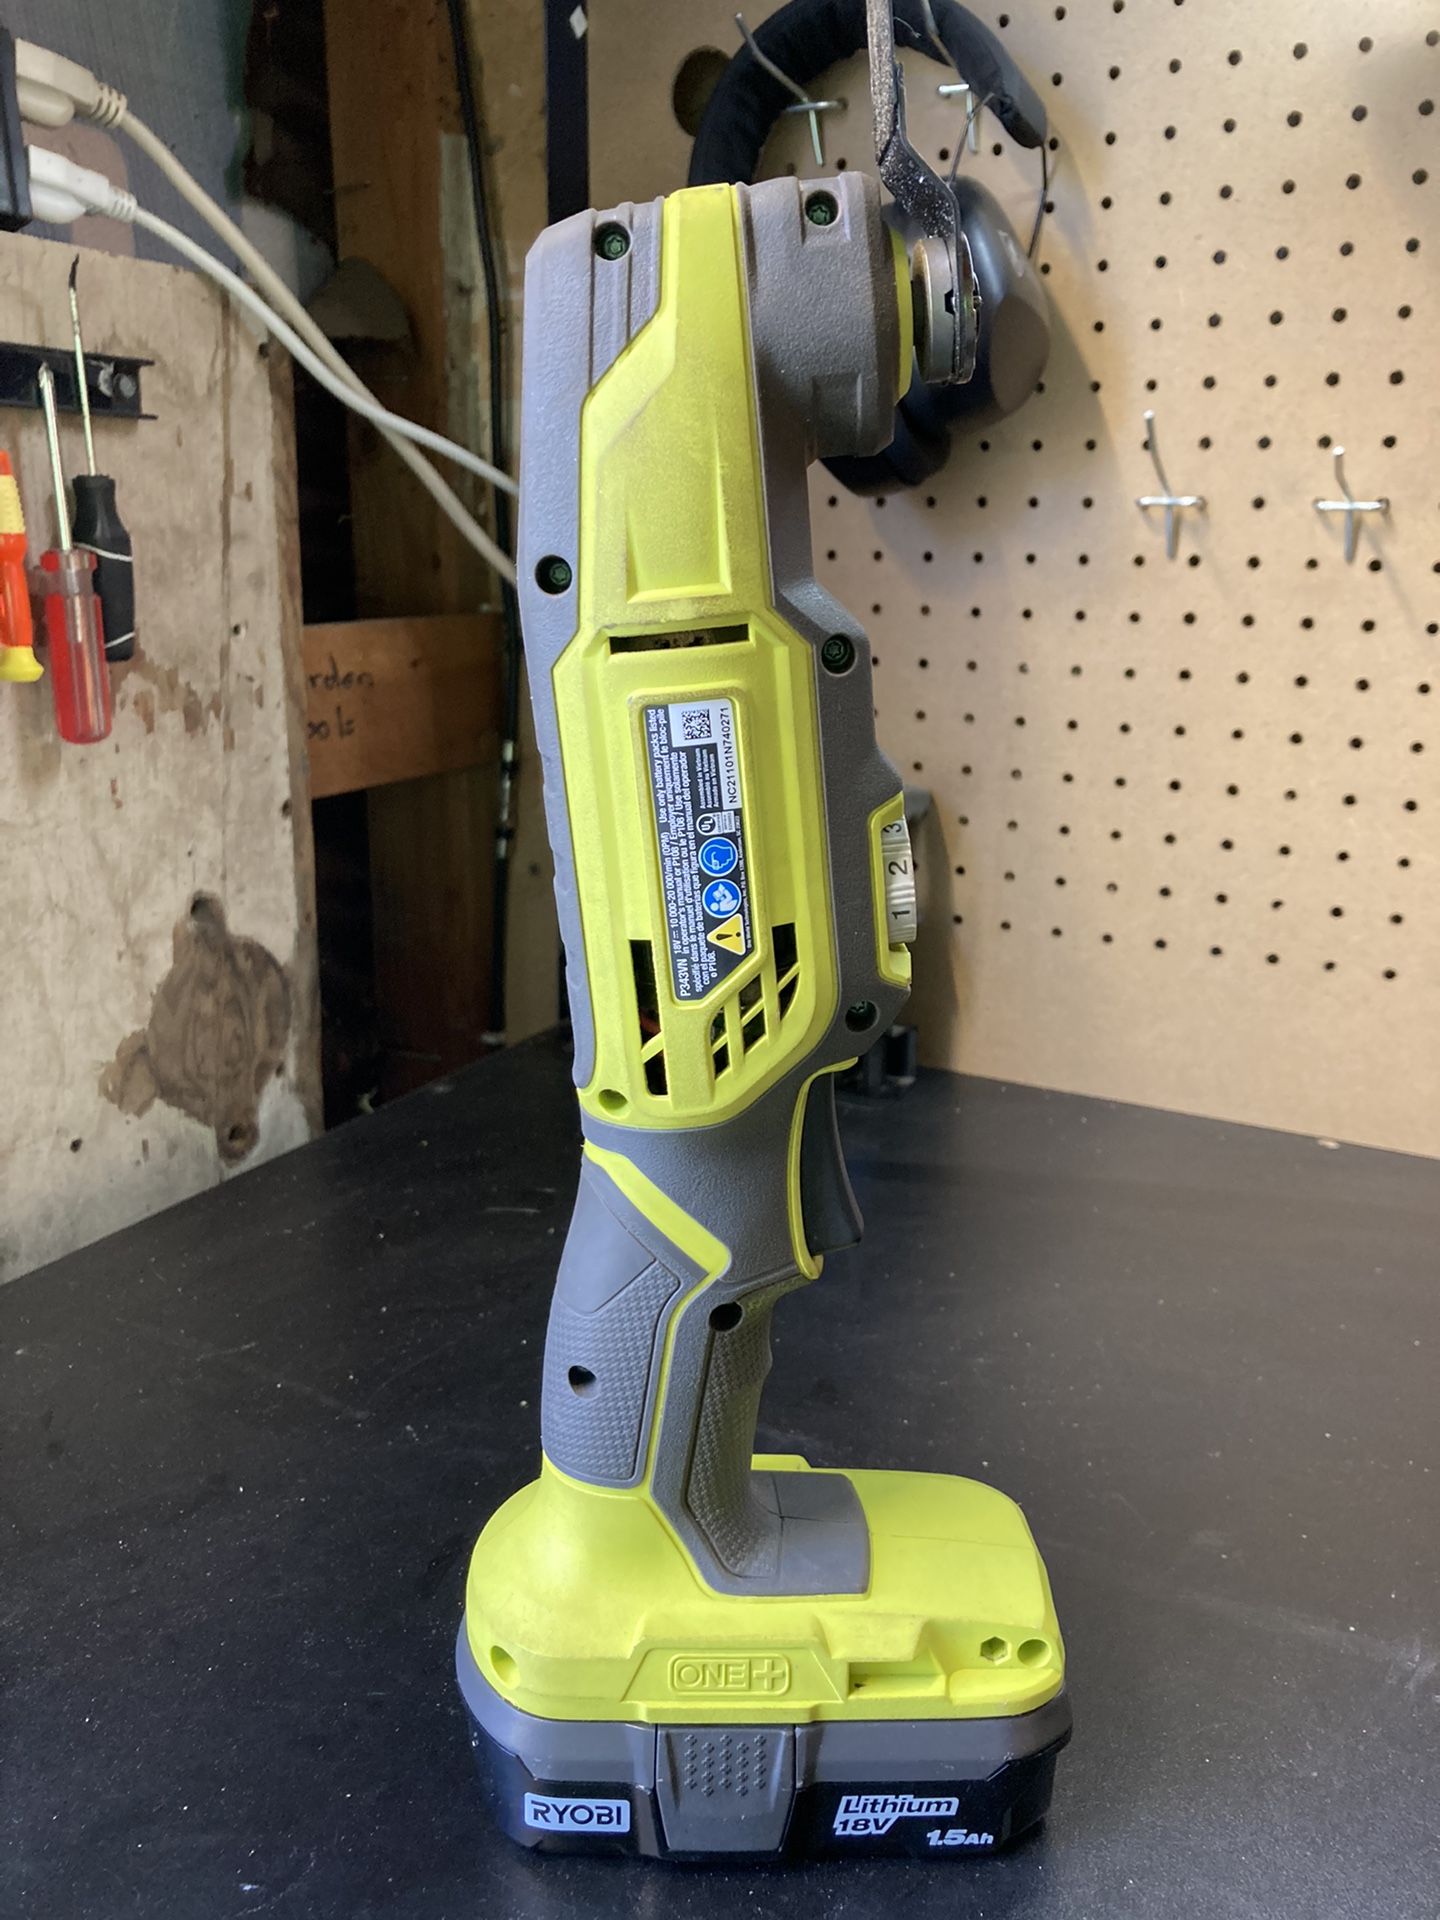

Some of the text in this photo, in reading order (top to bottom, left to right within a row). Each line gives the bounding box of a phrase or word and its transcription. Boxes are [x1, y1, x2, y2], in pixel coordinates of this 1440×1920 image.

[308, 653, 375, 691] rden
[655, 707, 669, 744] bloc-pile
[660, 745, 668, 753] le
[693, 747, 702, 771] Vietnam
[719, 706, 737, 803] NC21101N740271
[660, 753, 675, 801] uniquement
[669, 751, 681, 793] solamente
[677, 750, 691, 787] operador
[673, 794, 683, 810] Use
[681, 787, 691, 800] del
[666, 802, 679, 839] Employer
[676, 816, 686, 837] P108
[683, 801, 694, 831] manual
[700, 818, 714, 831] UL
[647, 708, 681, 953] 18V 10 000-20 000/min (OPM) Use only battery packs listed
[686, 831, 695, 839] el
[678, 838, 687, 846] le
[681, 847, 688, 857] ou
[689, 839, 696, 849] en
[670, 846, 680, 866] P108
[688, 850, 700, 873] figura
[674, 867, 681, 876] or
[692, 874, 702, 889] que
[882, 822, 910, 920] 1 2 3
[674, 877, 685, 905] manual
[677, 907, 690, 945] operator's
[685, 904, 696, 933] manuel
[696, 921, 704, 931] de
[688, 934, 697, 942] le
[697, 932, 709, 962] paquete
[681, 946, 690, 954] in
[689, 943, 699, 962] dans
[707, 950, 717, 971] P108.
[676, 958, 691, 996] P343VN
[702, 970, 710, 985] con
[531, 1800, 622, 1826] RYOBI
[842, 1797, 953, 1814] Lithium
[838, 1817, 890, 1832] 18V
[926, 1828, 994, 1846] 1.5Ah
